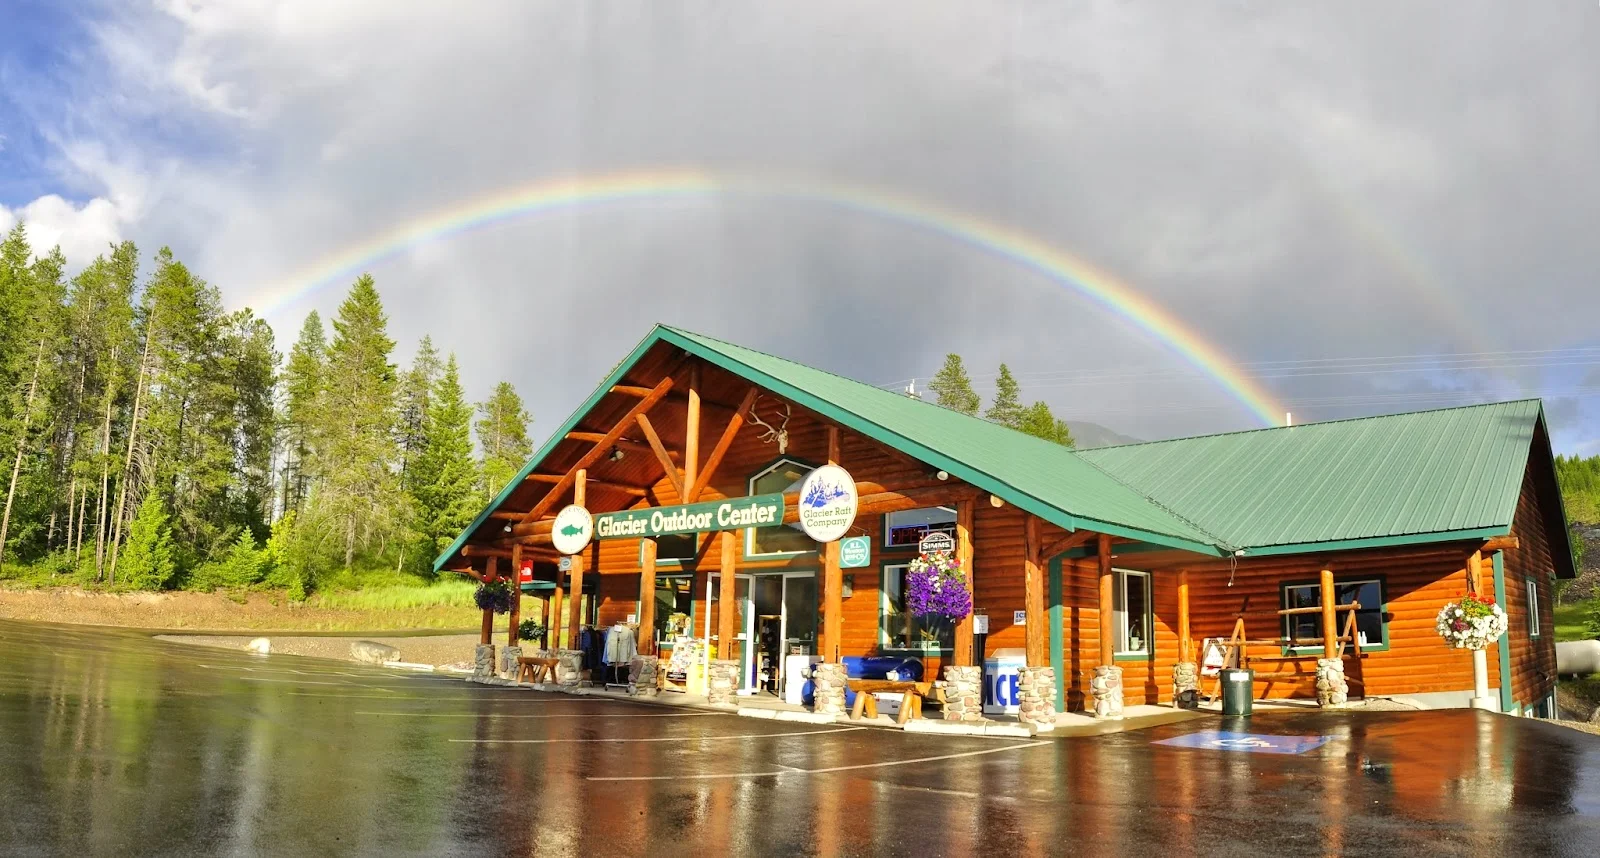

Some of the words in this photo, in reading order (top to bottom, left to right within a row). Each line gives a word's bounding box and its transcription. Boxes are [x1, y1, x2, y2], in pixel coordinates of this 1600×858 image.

[598, 514, 648, 537] Glacier
[651, 508, 712, 532] Outdoor
[717, 503, 777, 527] Center
[803, 509, 833, 519] Glacier
[835, 505, 852, 516] Raft
[806, 518, 847, 528] Company
[985, 674, 1020, 706] ICE
